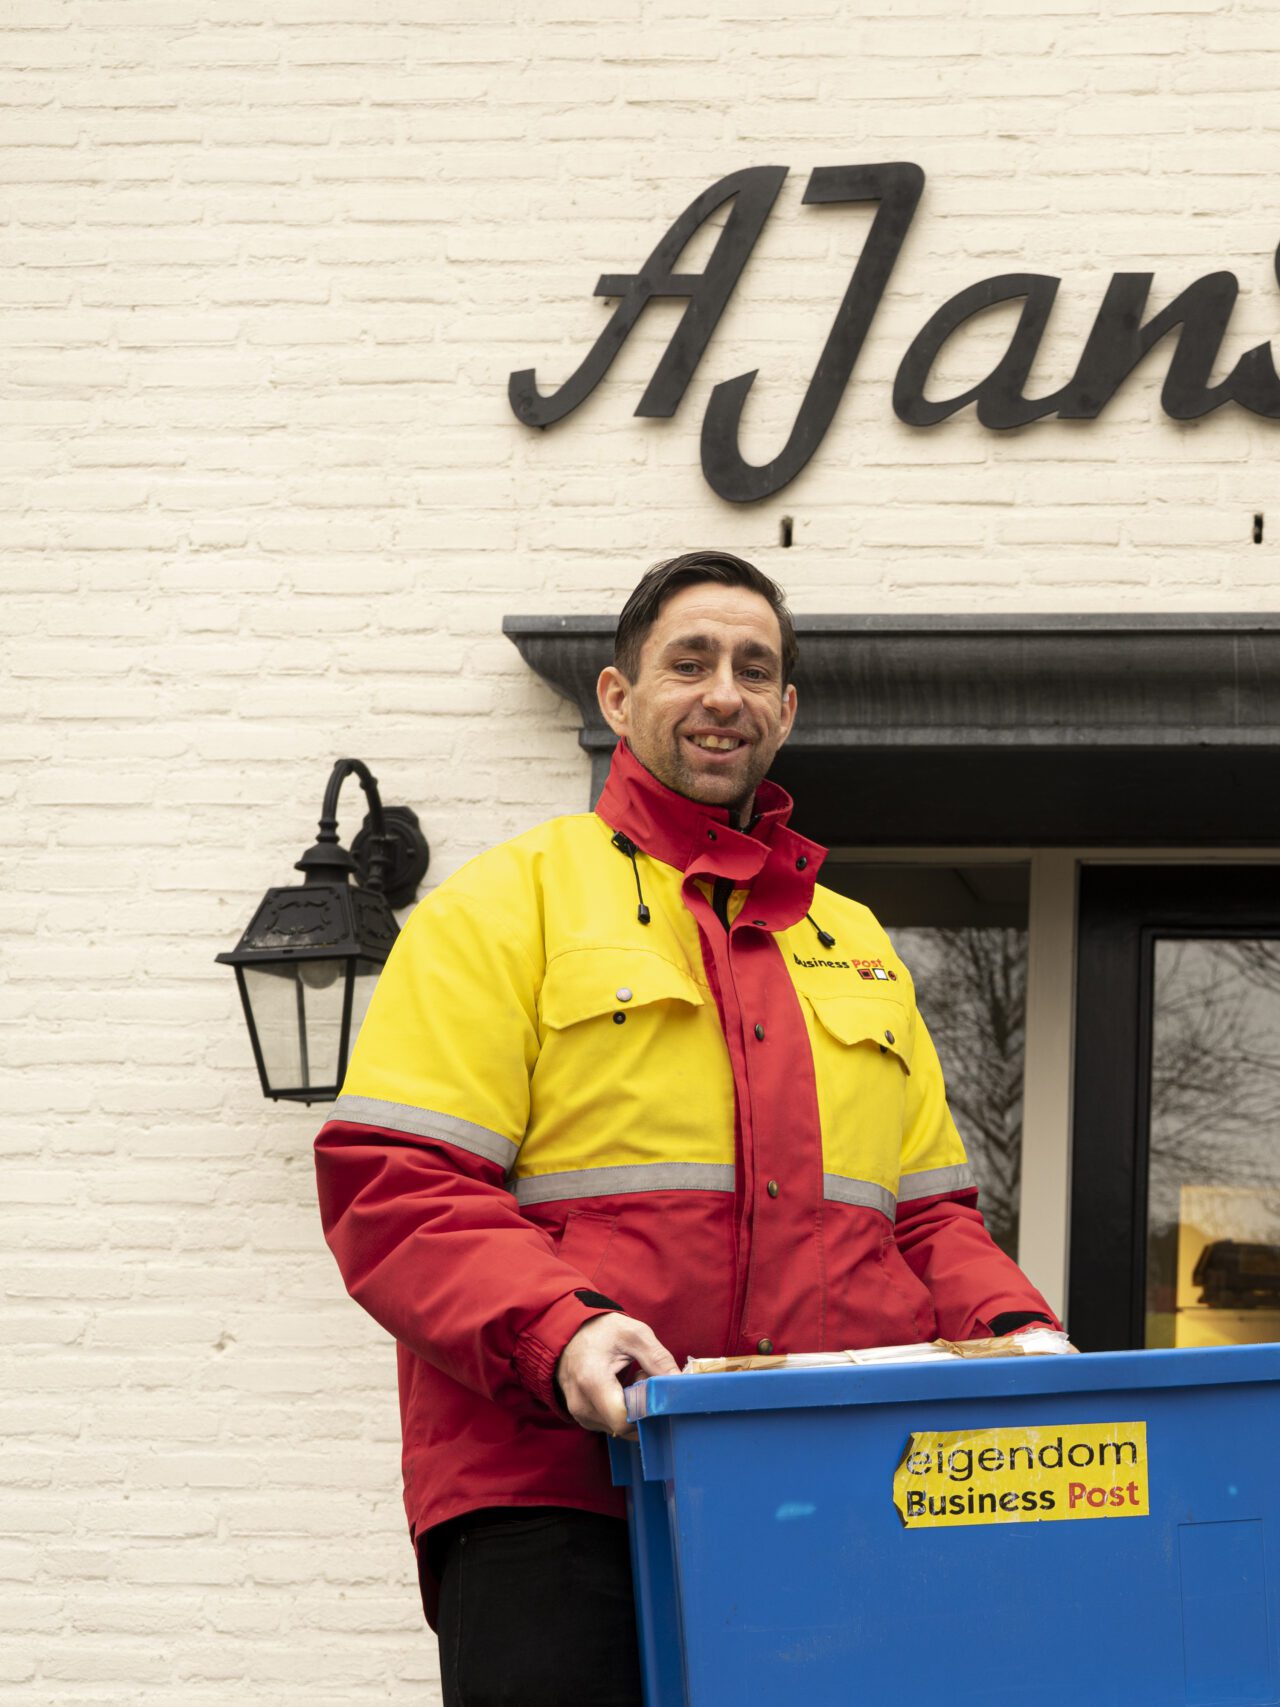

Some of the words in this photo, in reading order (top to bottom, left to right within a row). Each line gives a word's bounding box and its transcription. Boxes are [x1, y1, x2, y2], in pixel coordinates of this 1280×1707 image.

[906, 1437, 1137, 1482] eigendom
[906, 1487, 1056, 1517] Business
[1068, 1481, 1140, 1509] Post
